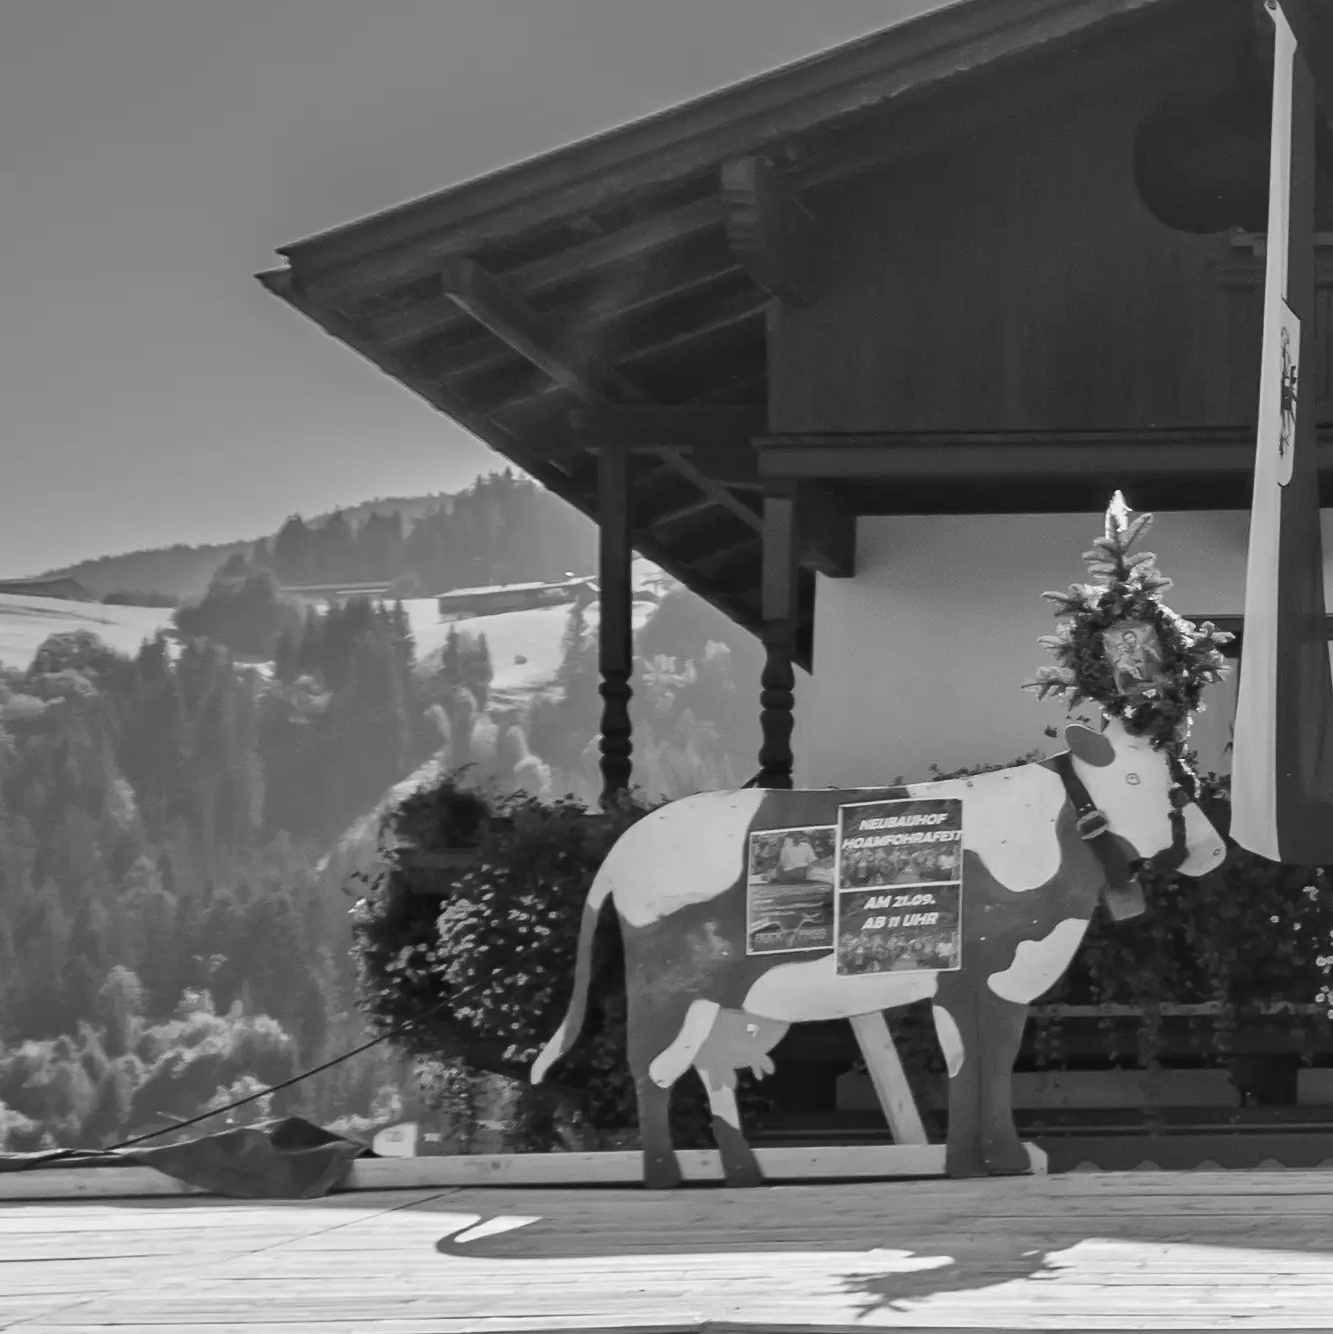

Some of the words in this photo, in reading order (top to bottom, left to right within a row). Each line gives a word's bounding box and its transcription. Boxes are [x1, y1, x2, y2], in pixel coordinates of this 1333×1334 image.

[859, 813, 948, 831] NEUBAUHOF
[864, 895, 892, 910] AM
[861, 916, 887, 930] AB
[903, 912, 940, 927] UHR
